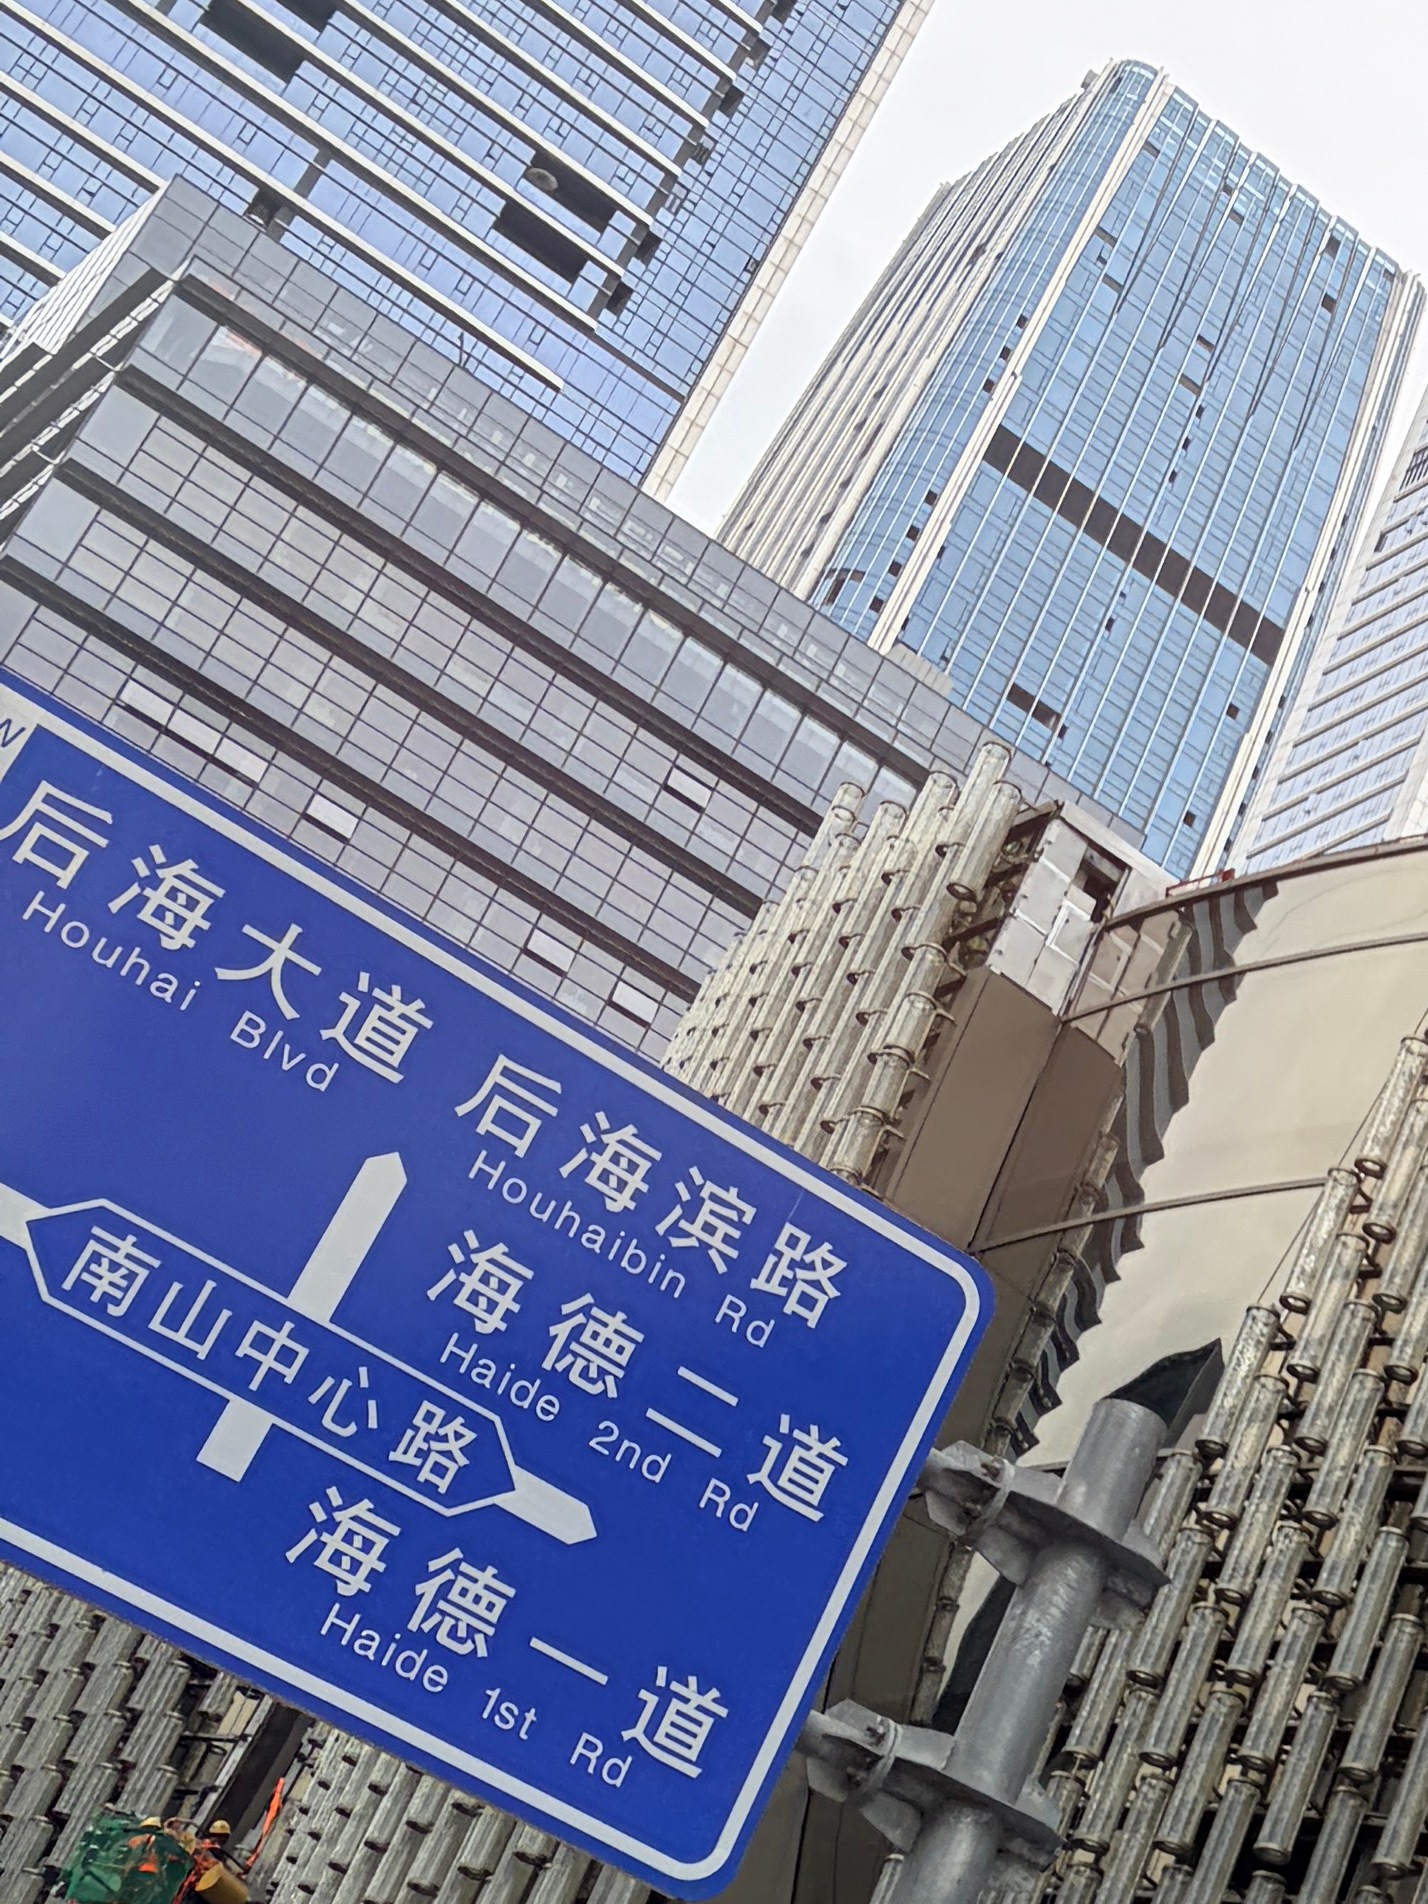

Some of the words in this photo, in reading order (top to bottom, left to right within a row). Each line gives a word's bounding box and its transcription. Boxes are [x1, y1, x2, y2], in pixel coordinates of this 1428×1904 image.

[0, 780, 433, 1083] 后海大道
[22, 891, 200, 1010] Houhai
[230, 1011, 339, 1091] Blvd
[454, 1054, 847, 1328] 后海滨路
[469, 1150, 685, 1298] Houhaibin
[715, 1295, 774, 1347] Rd
[62, 1226, 477, 1493] 南山中心路
[427, 1230, 848, 1521] 海德二道
[440, 1333, 559, 1420] Haide
[589, 1421, 671, 1482] 2nd
[700, 1479, 758, 1531] Rd
[286, 1486, 728, 1778] 海德一道
[321, 1603, 447, 1692] Haide
[483, 1689, 536, 1739] 1st
[570, 1733, 632, 1787] Rd
